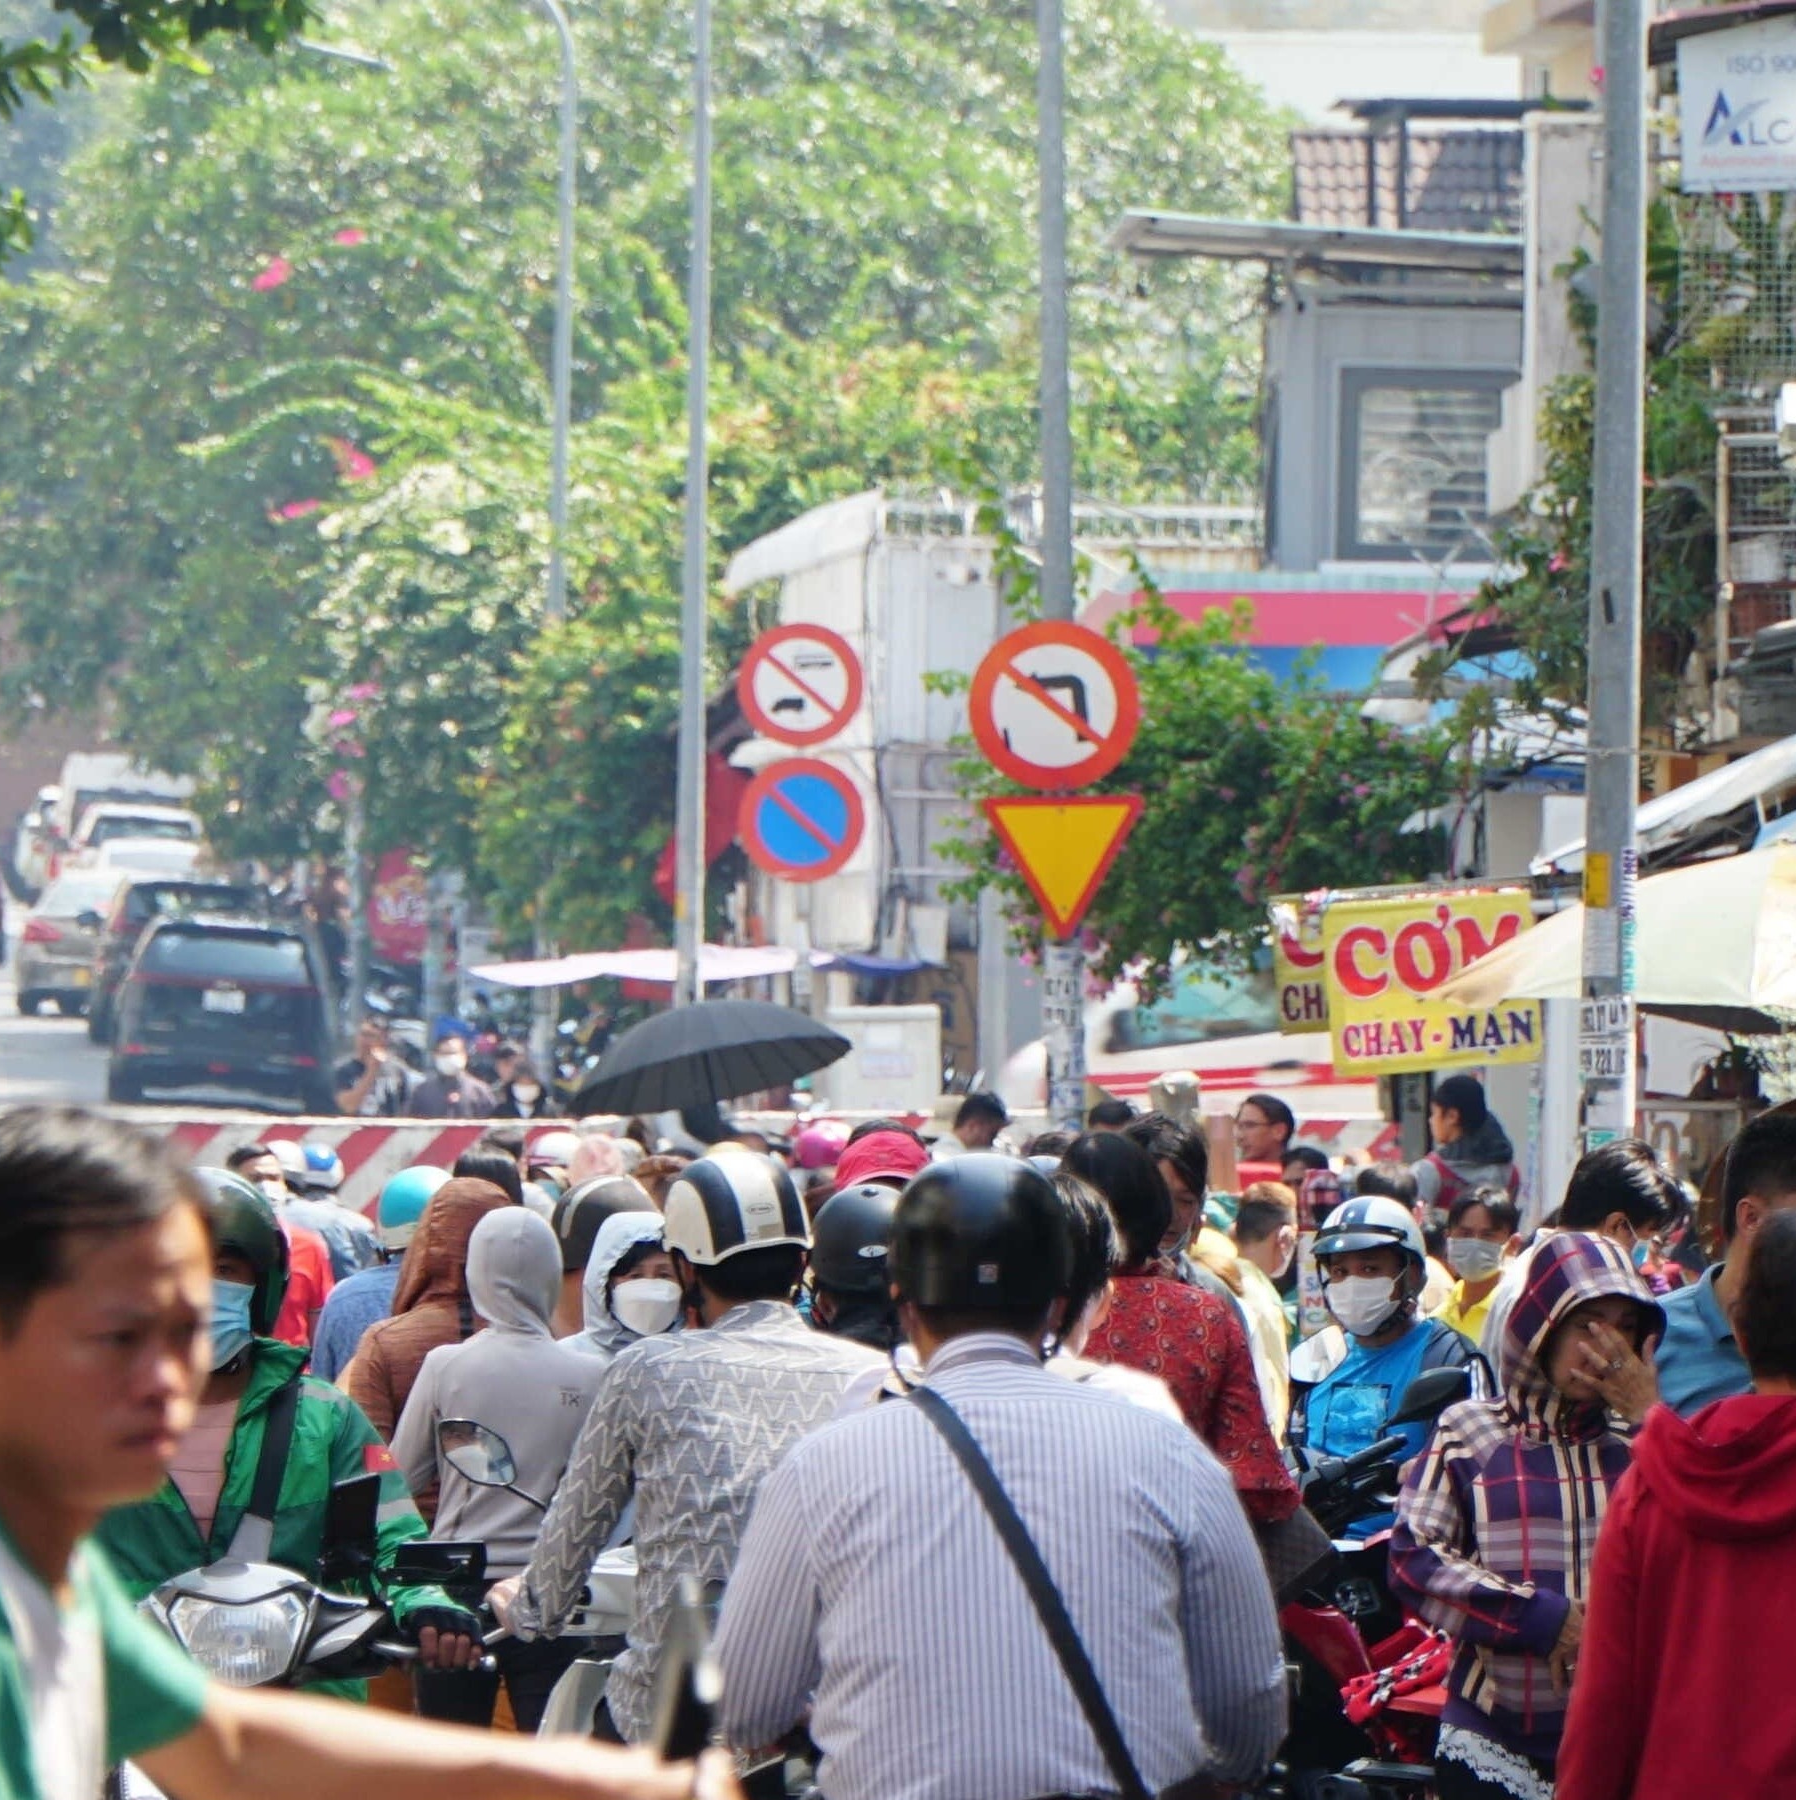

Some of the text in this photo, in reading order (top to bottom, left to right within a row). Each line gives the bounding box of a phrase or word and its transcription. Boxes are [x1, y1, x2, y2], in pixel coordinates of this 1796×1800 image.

[1334, 905, 1521, 997] CƠM
[1343, 1018, 1425, 1058] CHAY
[1449, 1009, 1533, 1055] MẠN
